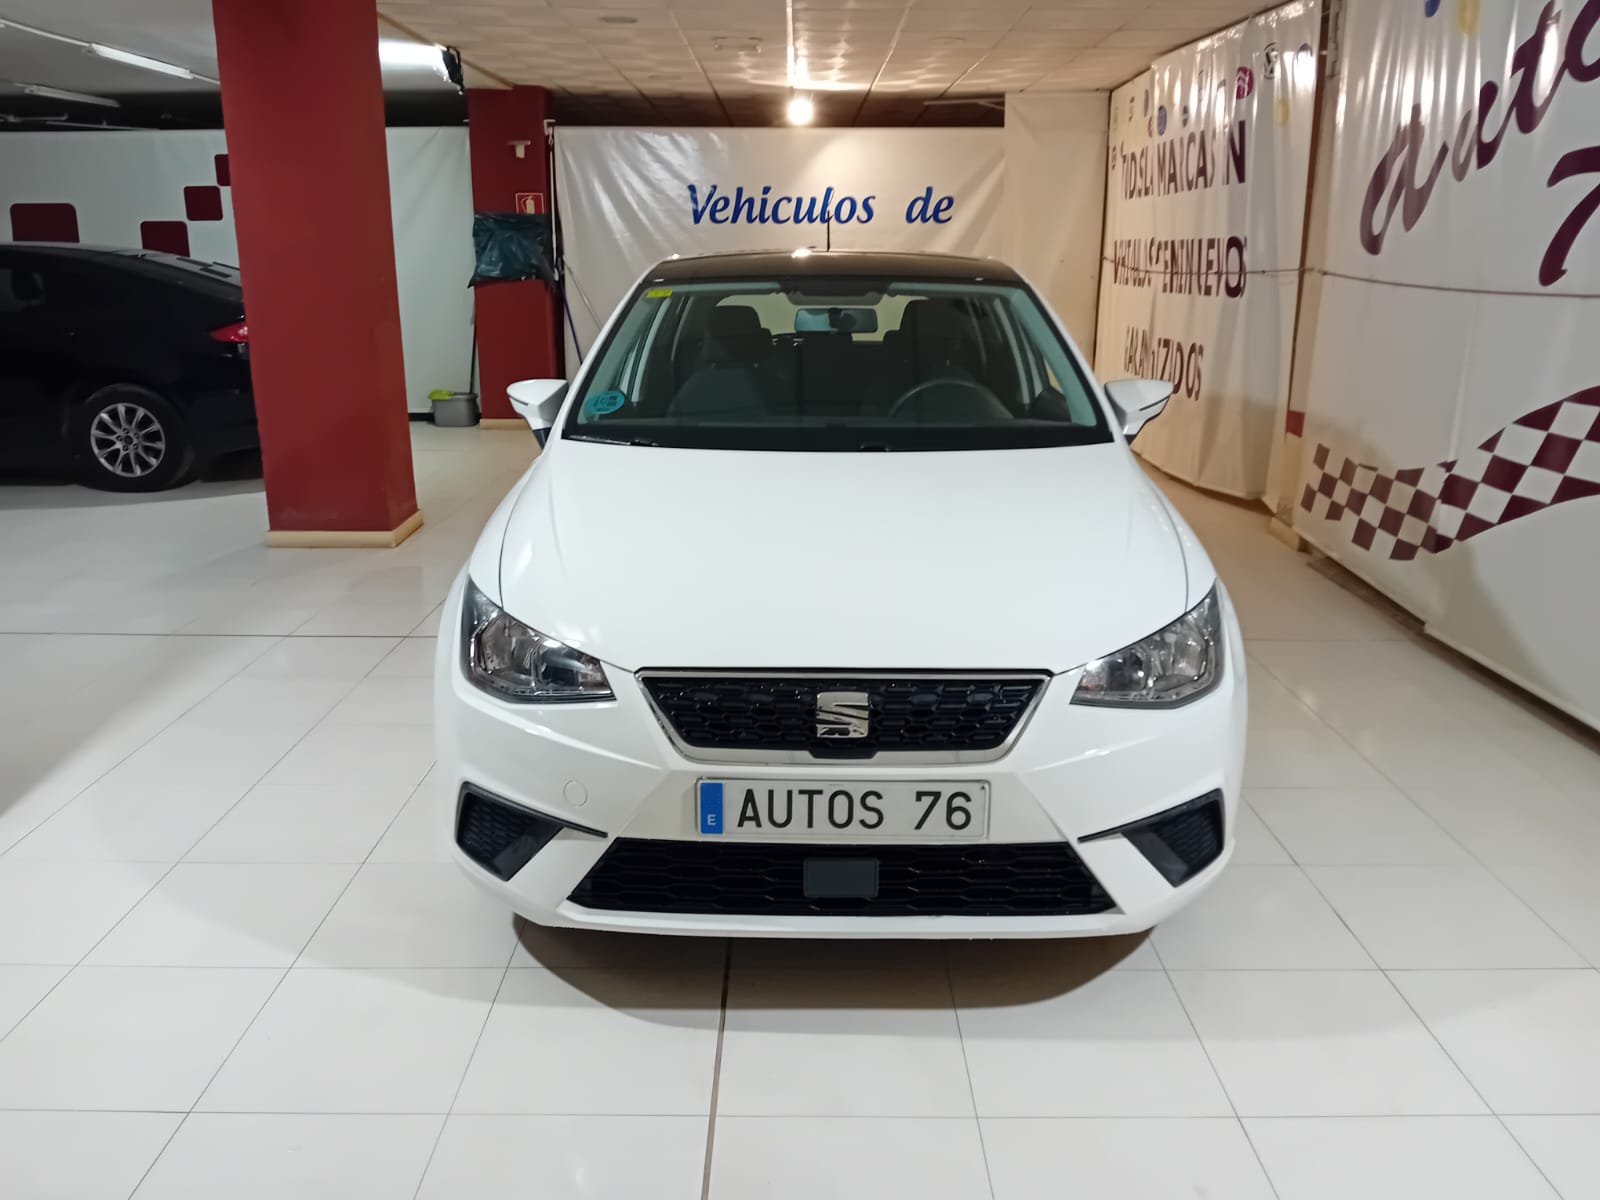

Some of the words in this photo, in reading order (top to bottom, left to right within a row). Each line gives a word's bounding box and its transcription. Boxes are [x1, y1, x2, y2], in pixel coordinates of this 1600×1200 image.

[905, 185, 954, 223] de
[706, 814, 718, 826] E
[737, 788, 885, 829] AUTOS
[914, 791, 972, 830] 76
